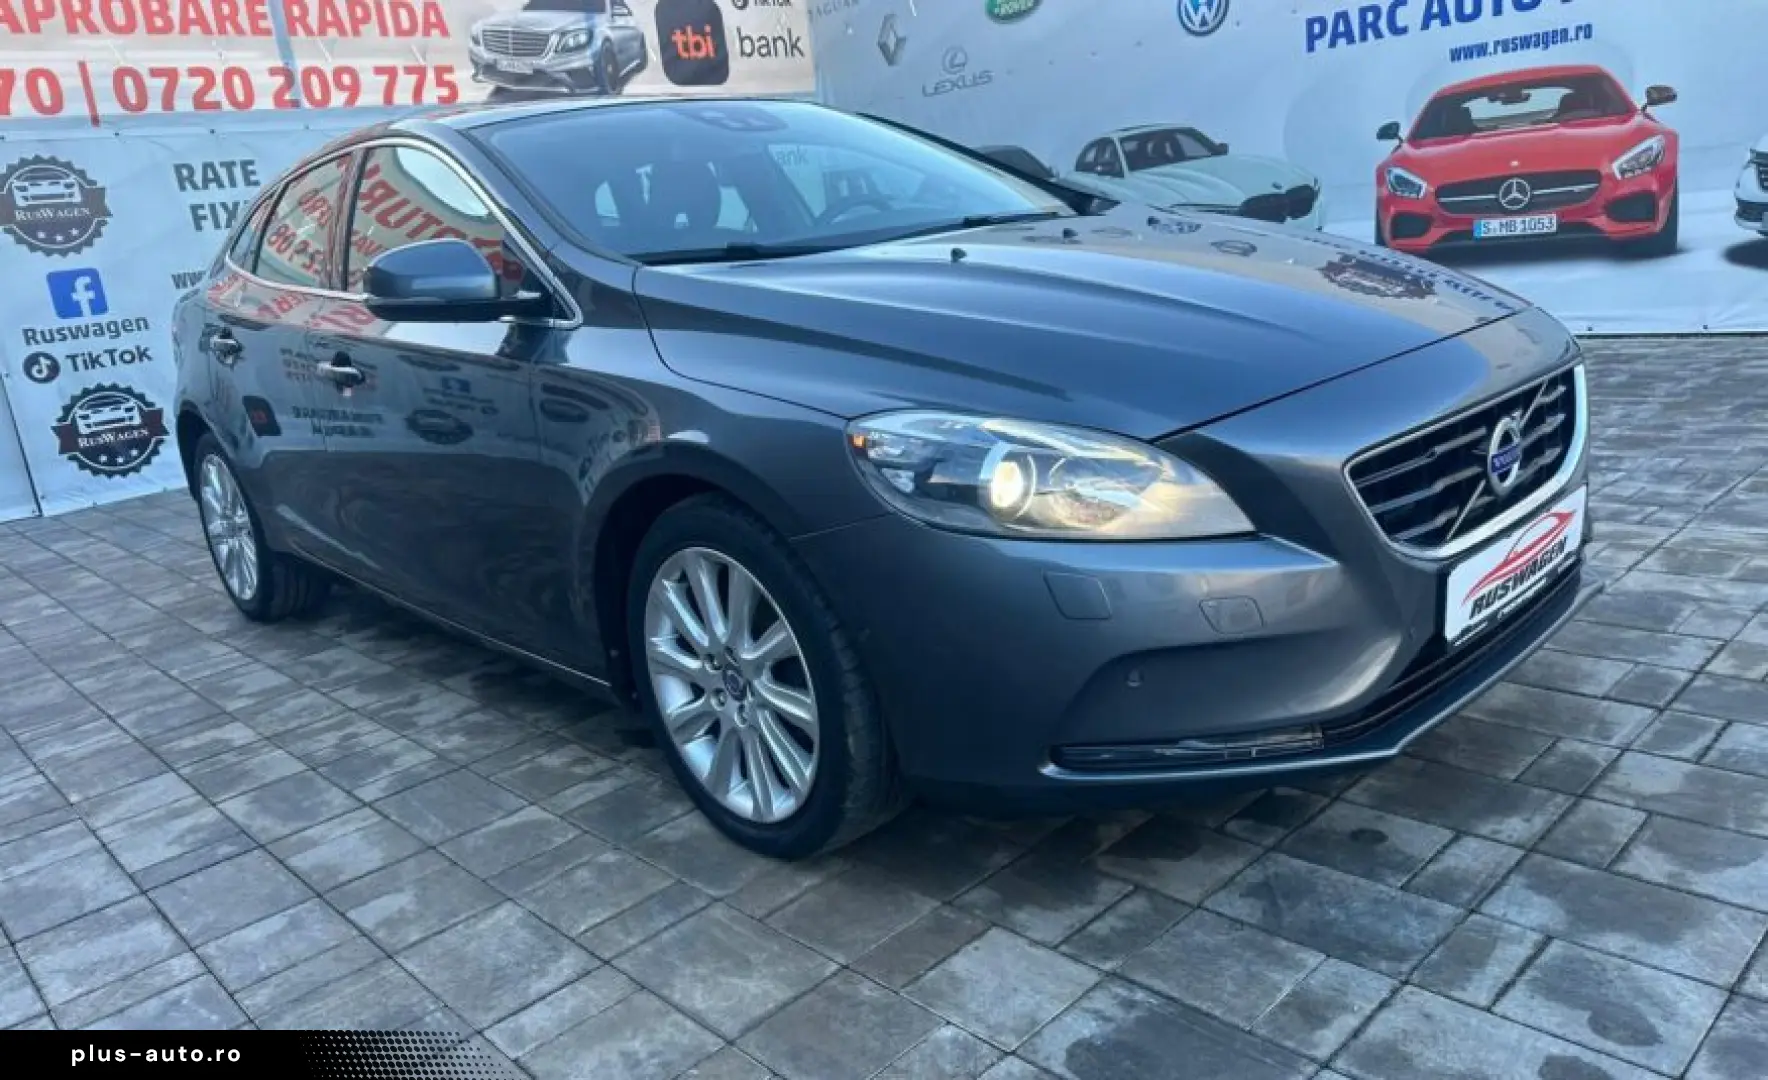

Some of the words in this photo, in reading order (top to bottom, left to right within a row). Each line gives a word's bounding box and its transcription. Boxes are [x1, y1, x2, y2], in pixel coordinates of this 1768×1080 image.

[0, 0, 272, 37] APROBARE
[289, 0, 449, 38] RAPIDA
[1305, 0, 1409, 53] PARC
[671, 25, 716, 61] tbi
[736, 26, 804, 58] bank
[1449, 23, 1594, 63] www.ruswagen.ro
[112, 65, 256, 113] 0720
[268, 62, 362, 110] 209
[372, 65, 459, 107] 775
[922, 70, 994, 97] LEXUS
[173, 159, 261, 192] RATE
[189, 199, 249, 232] FIX
[22, 316, 150, 346] Ruswagen
[65, 345, 154, 373] TikTok
[1469, 535, 1568, 620] RUSWAGEN
